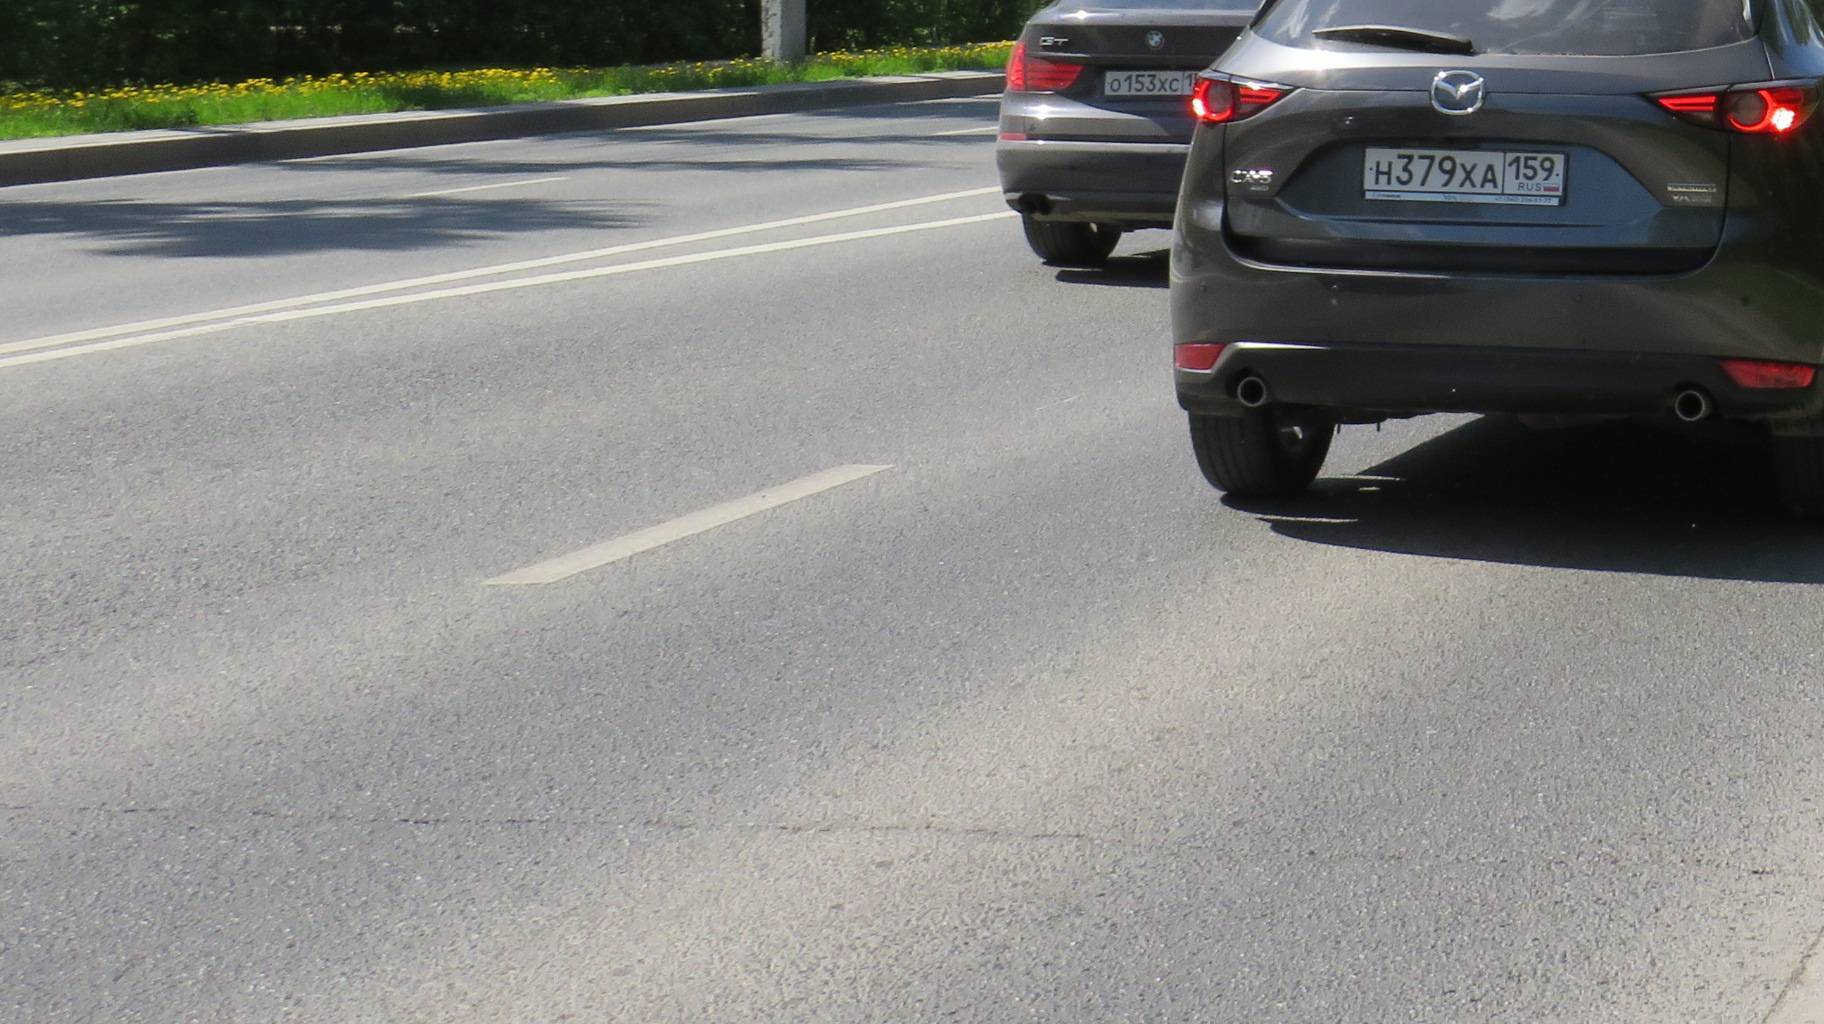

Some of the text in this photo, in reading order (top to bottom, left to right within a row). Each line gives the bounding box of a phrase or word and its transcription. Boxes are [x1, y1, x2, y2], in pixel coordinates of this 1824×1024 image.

[1374, 153, 1556, 189] Н379ХА 159
[1517, 181, 1542, 192] RUS
